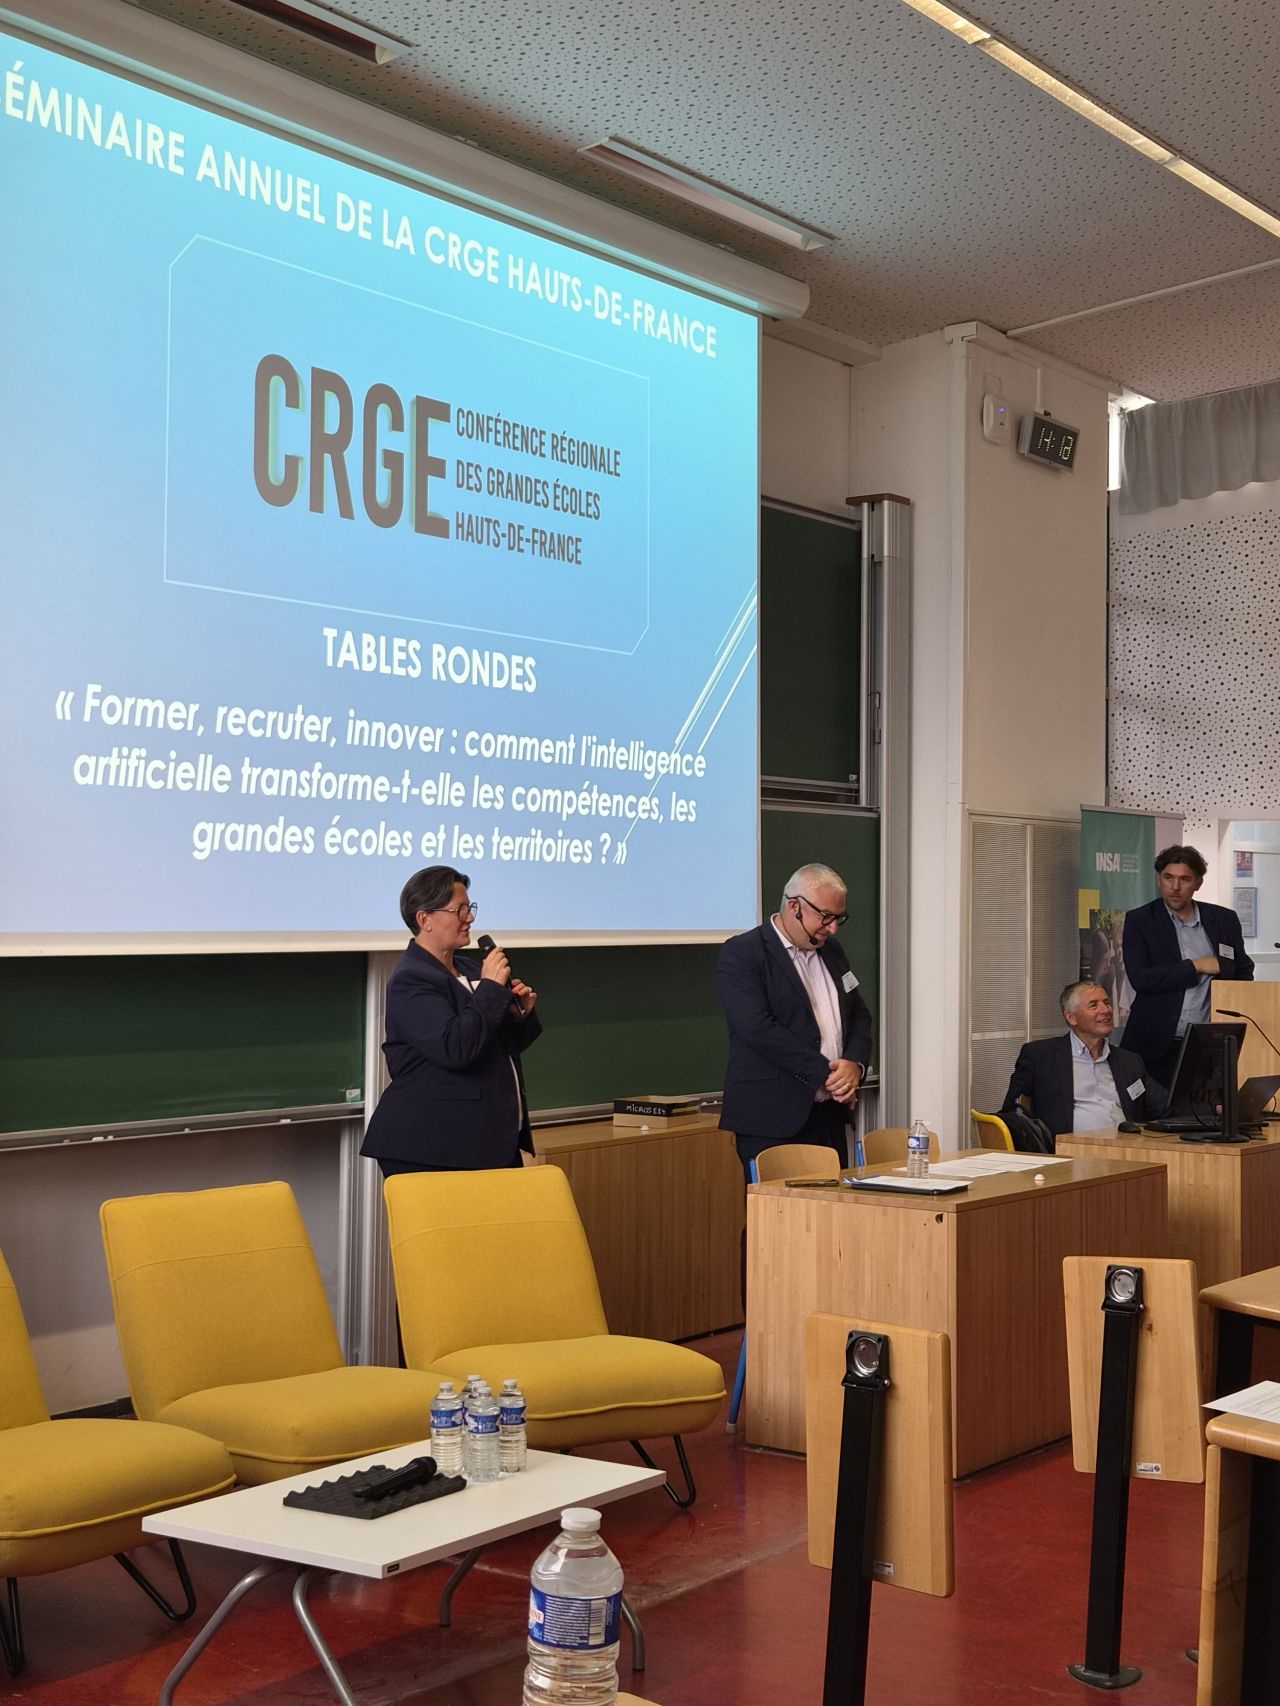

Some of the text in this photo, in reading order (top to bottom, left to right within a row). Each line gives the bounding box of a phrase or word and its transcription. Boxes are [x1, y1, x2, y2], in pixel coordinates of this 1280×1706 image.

[0, 60, 716, 357] ÉMINAIRE ANNUEL DE LA CRGE HAUTS-DE-FRANCE
[254, 354, 451, 539] CRGE
[456, 407, 621, 478] CONFÉRENCE RÉGIONALE
[456, 458, 601, 521] DES GRANDES ÉCOLES
[455, 511, 583, 566] HAUTS-DE-FRANCE
[323, 628, 536, 692] TABLES RONDES
[84, 684, 204, 736] Former,
[216, 705, 336, 747] recruter,
[347, 709, 444, 752] innover
[451, 730, 457, 754] :
[465, 731, 575, 764] comment
[581, 736, 706, 779] l'intelligence
[74, 747, 696, 823] artificielle transforme-t-elle les compétences, les
[193, 816, 314, 860] grandes
[325, 816, 412, 856] écoles
[421, 825, 446, 857] et
[452, 825, 484, 859] les
[492, 827, 592, 863] territoires
[600, 833, 611, 864] ?
[1096, 852, 1120, 872] INSA
